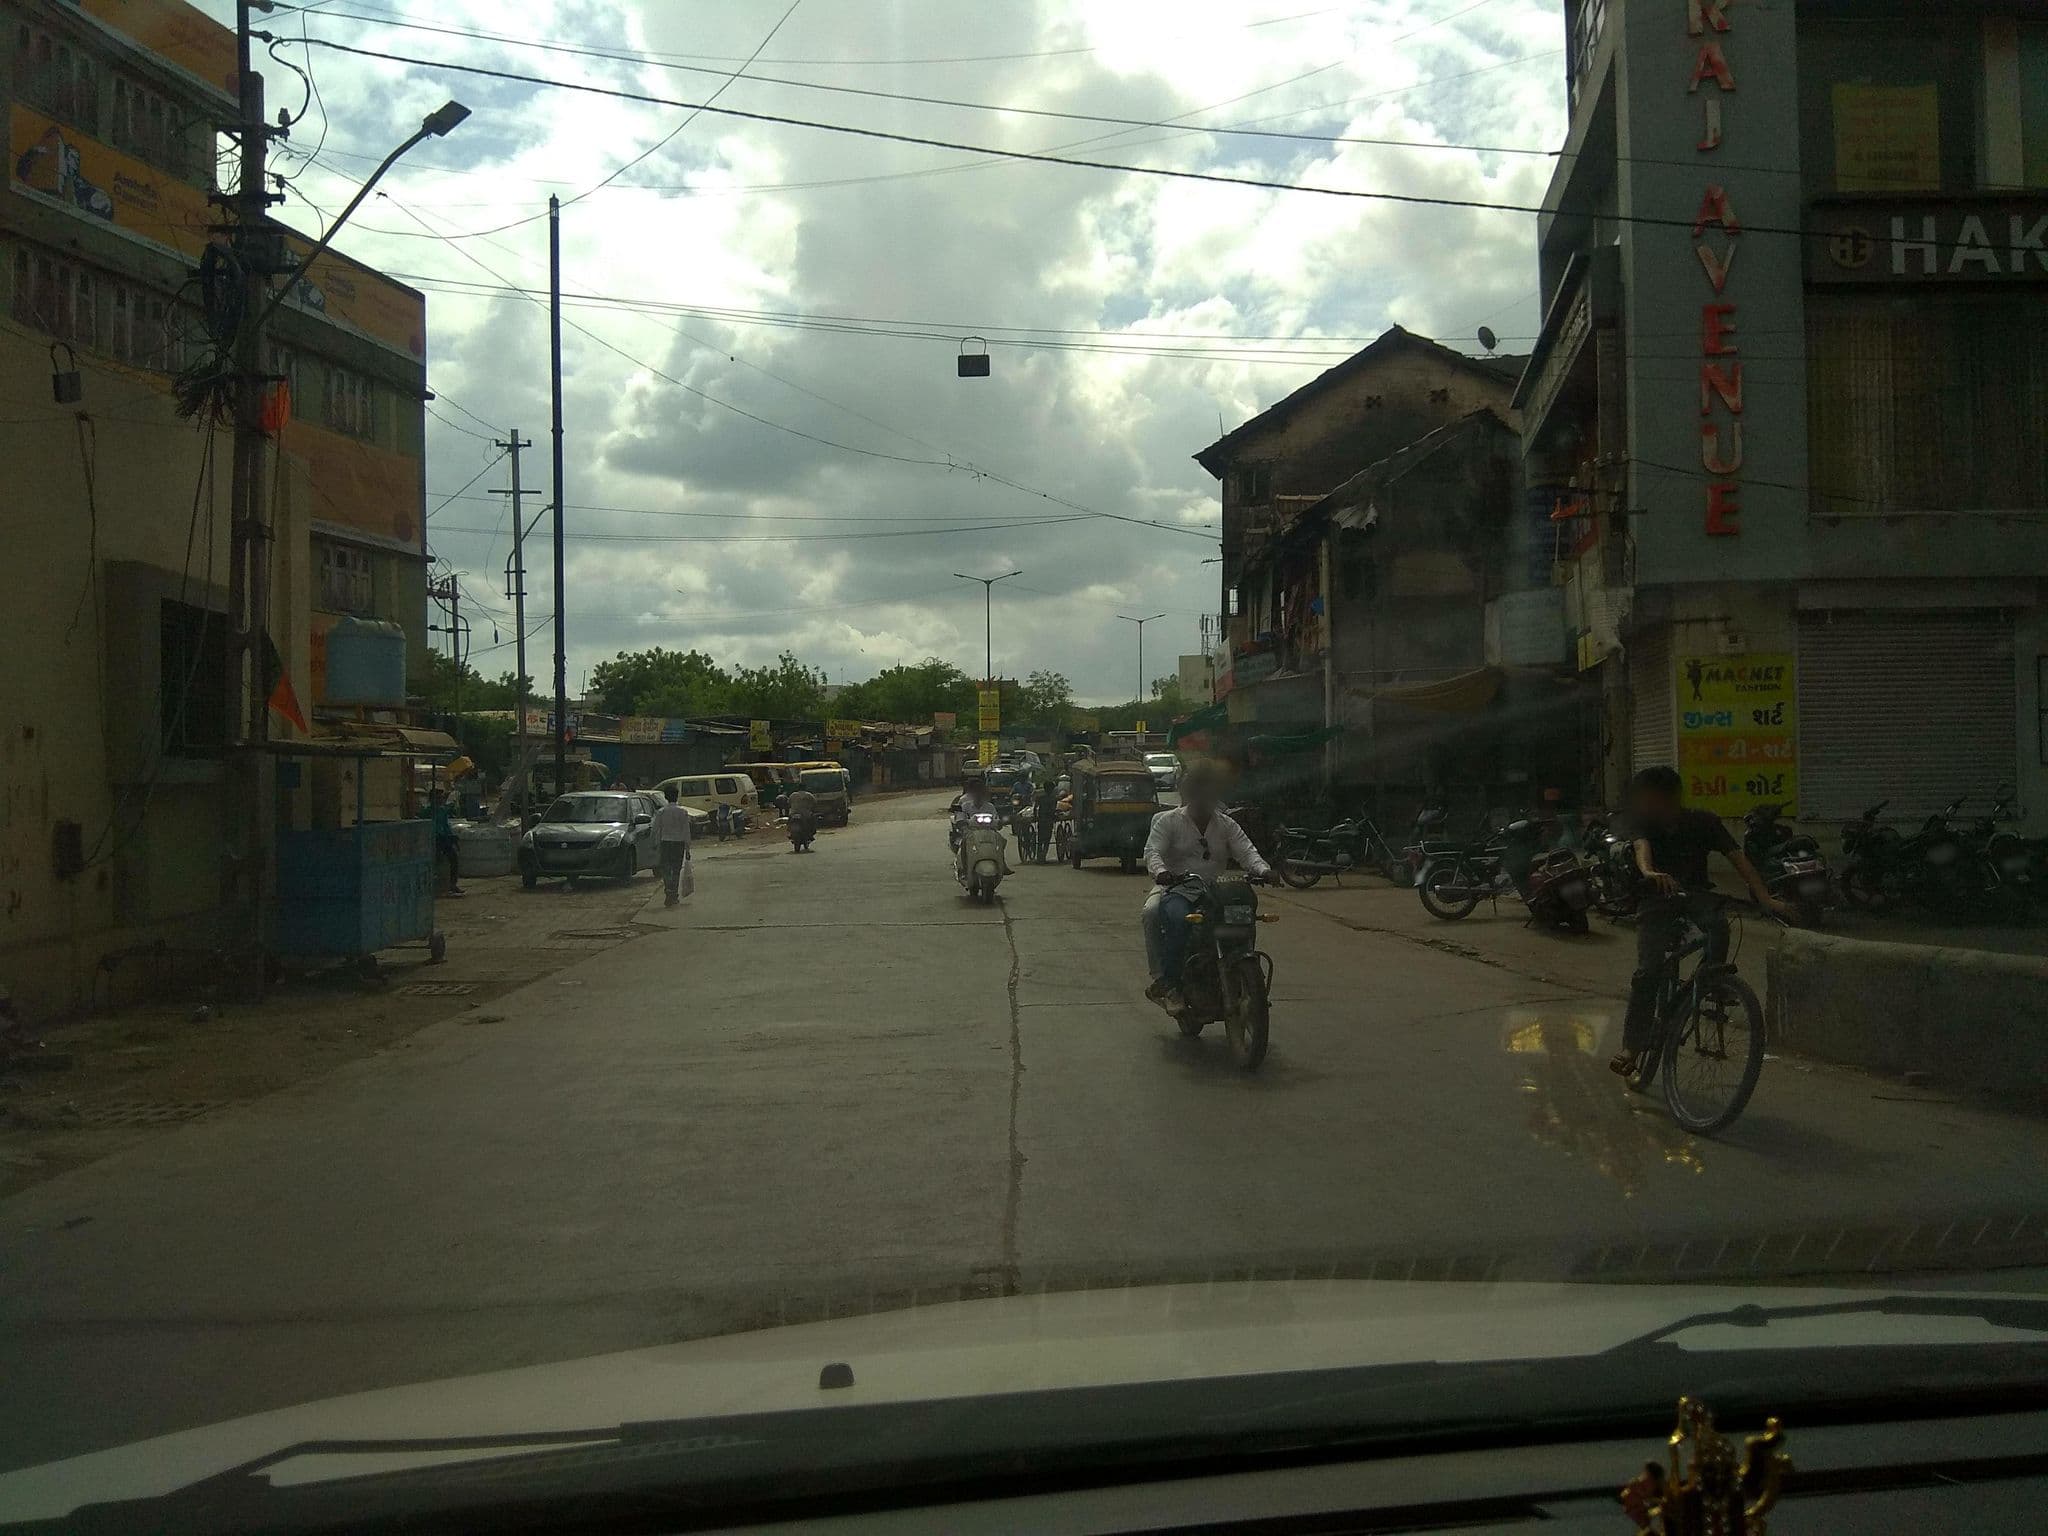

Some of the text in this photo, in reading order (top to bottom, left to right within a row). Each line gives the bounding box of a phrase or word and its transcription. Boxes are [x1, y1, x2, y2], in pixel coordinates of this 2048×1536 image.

[1692, 183, 1743, 536] AVENUE
[1735, 684, 1781, 693] FASHION
[1752, 702, 1785, 726] શર્ટ
